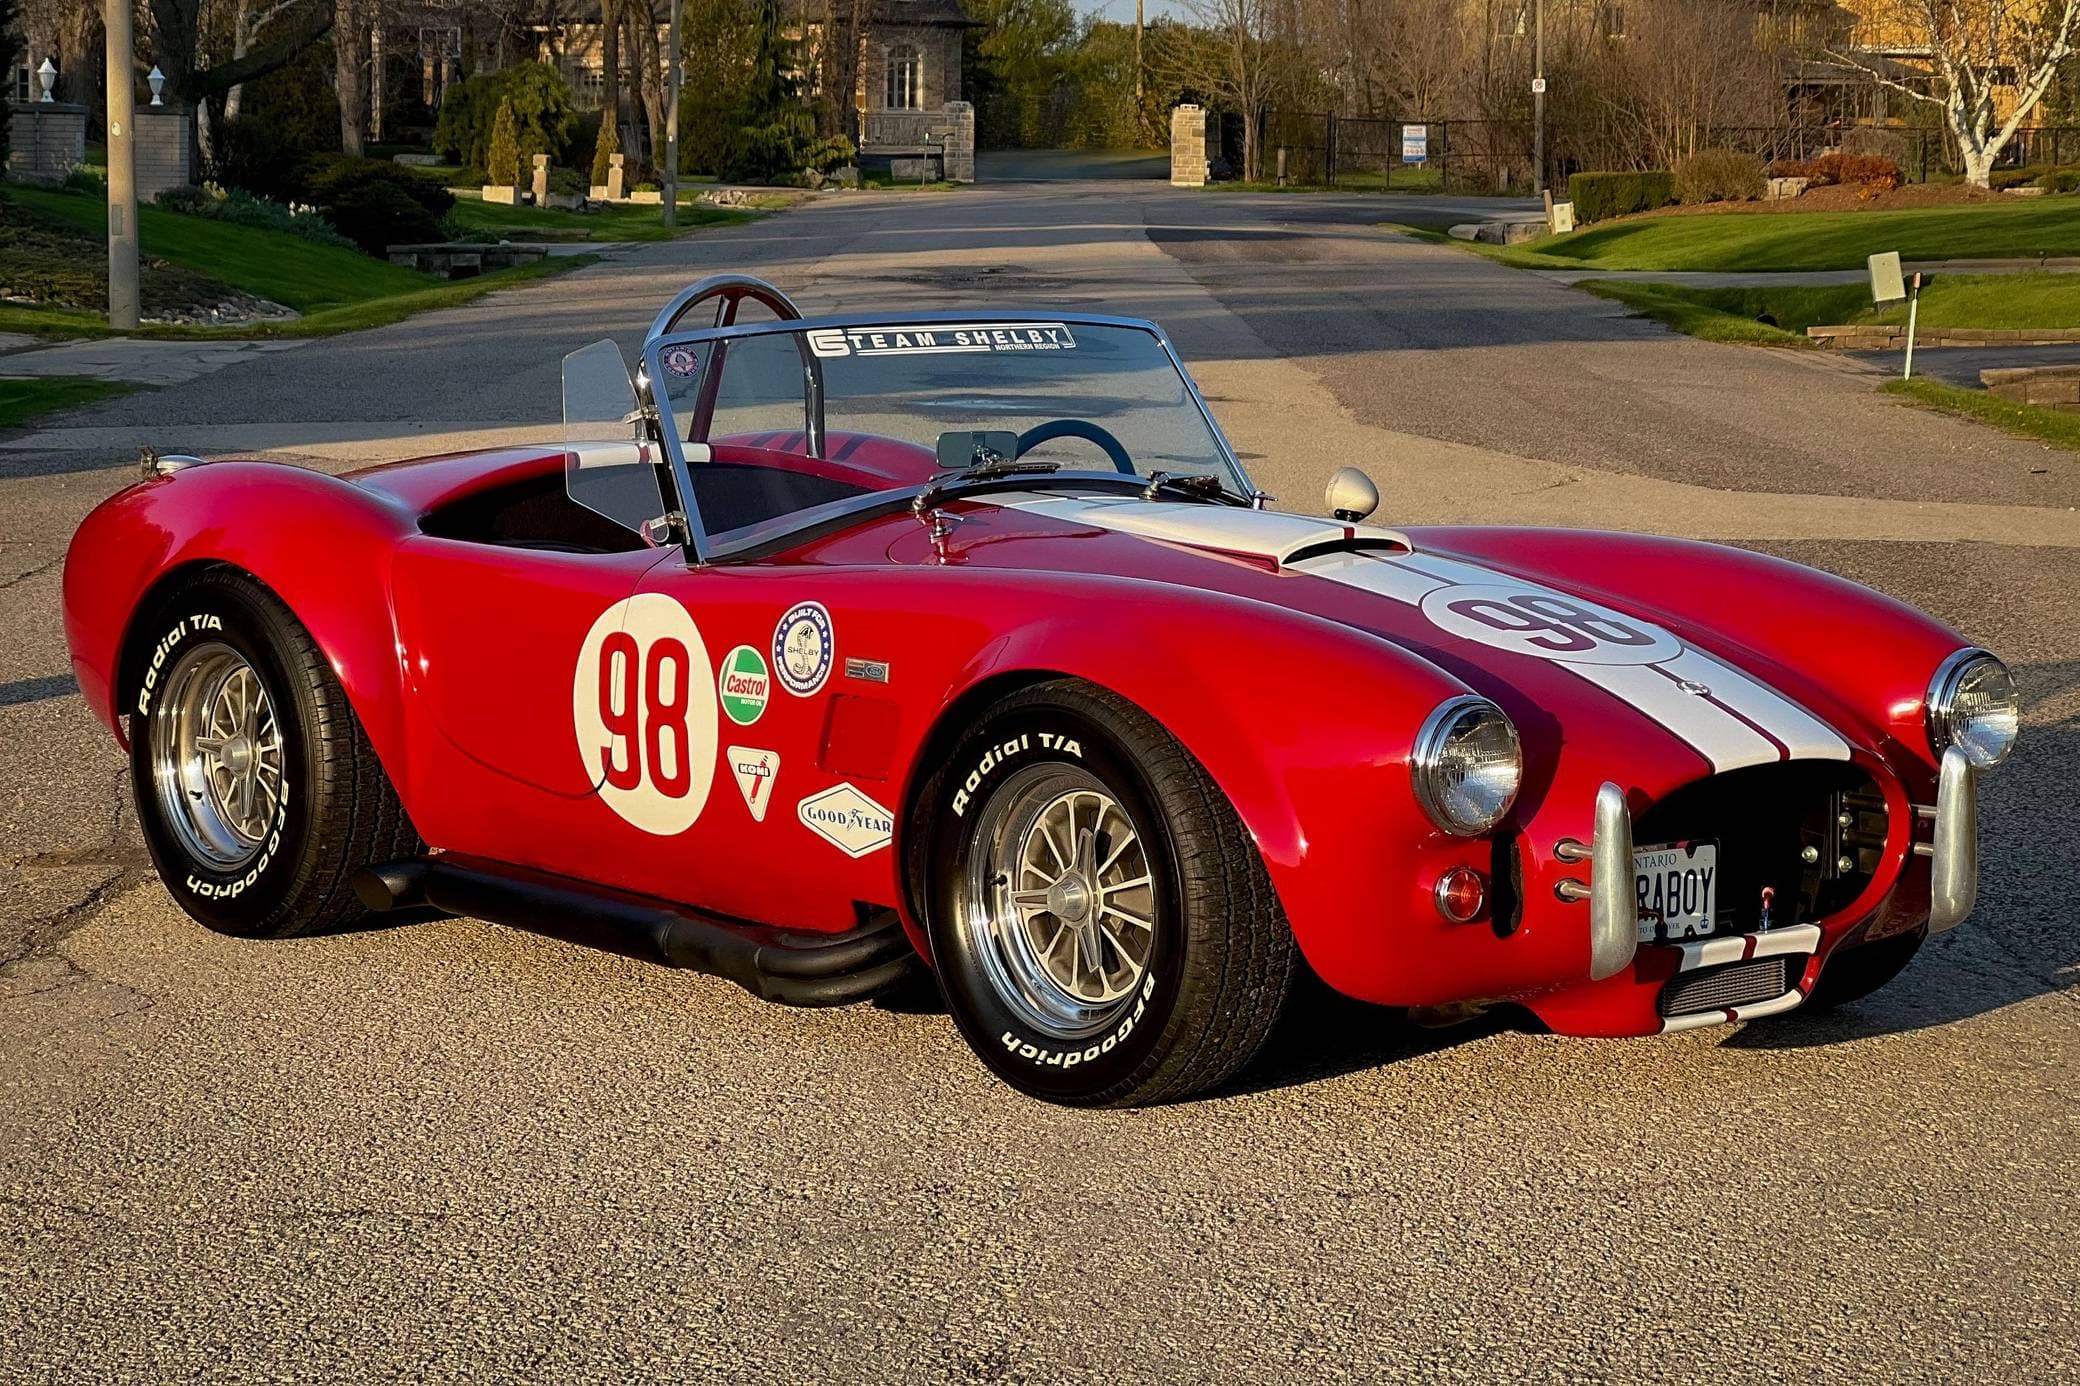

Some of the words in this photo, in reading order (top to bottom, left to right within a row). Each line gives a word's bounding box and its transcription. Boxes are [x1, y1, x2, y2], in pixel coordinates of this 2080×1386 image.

[848, 332, 936, 349] TEAM
[957, 330, 1059, 346] SHELBY
[788, 608, 813, 623] BUILT
[812, 610, 826, 630] FOR
[1447, 595, 1657, 652] 98
[138, 621, 186, 716] Radial
[190, 614, 222, 631] T/A
[787, 646, 820, 656] SHELBY
[727, 675, 767, 696] Castrol
[777, 656, 827, 690] PERFORMANCE
[599, 631, 691, 799] 98
[740, 764, 769, 776] KONI
[952, 734, 1029, 817] Radial
[1038, 733, 1083, 758] T/A
[186, 778, 289, 900] BFGoodrich
[1635, 853, 1677, 868] NTARIO
[1636, 867, 1713, 918] RABOY
[1001, 972, 1157, 1070] BFGoodrich
